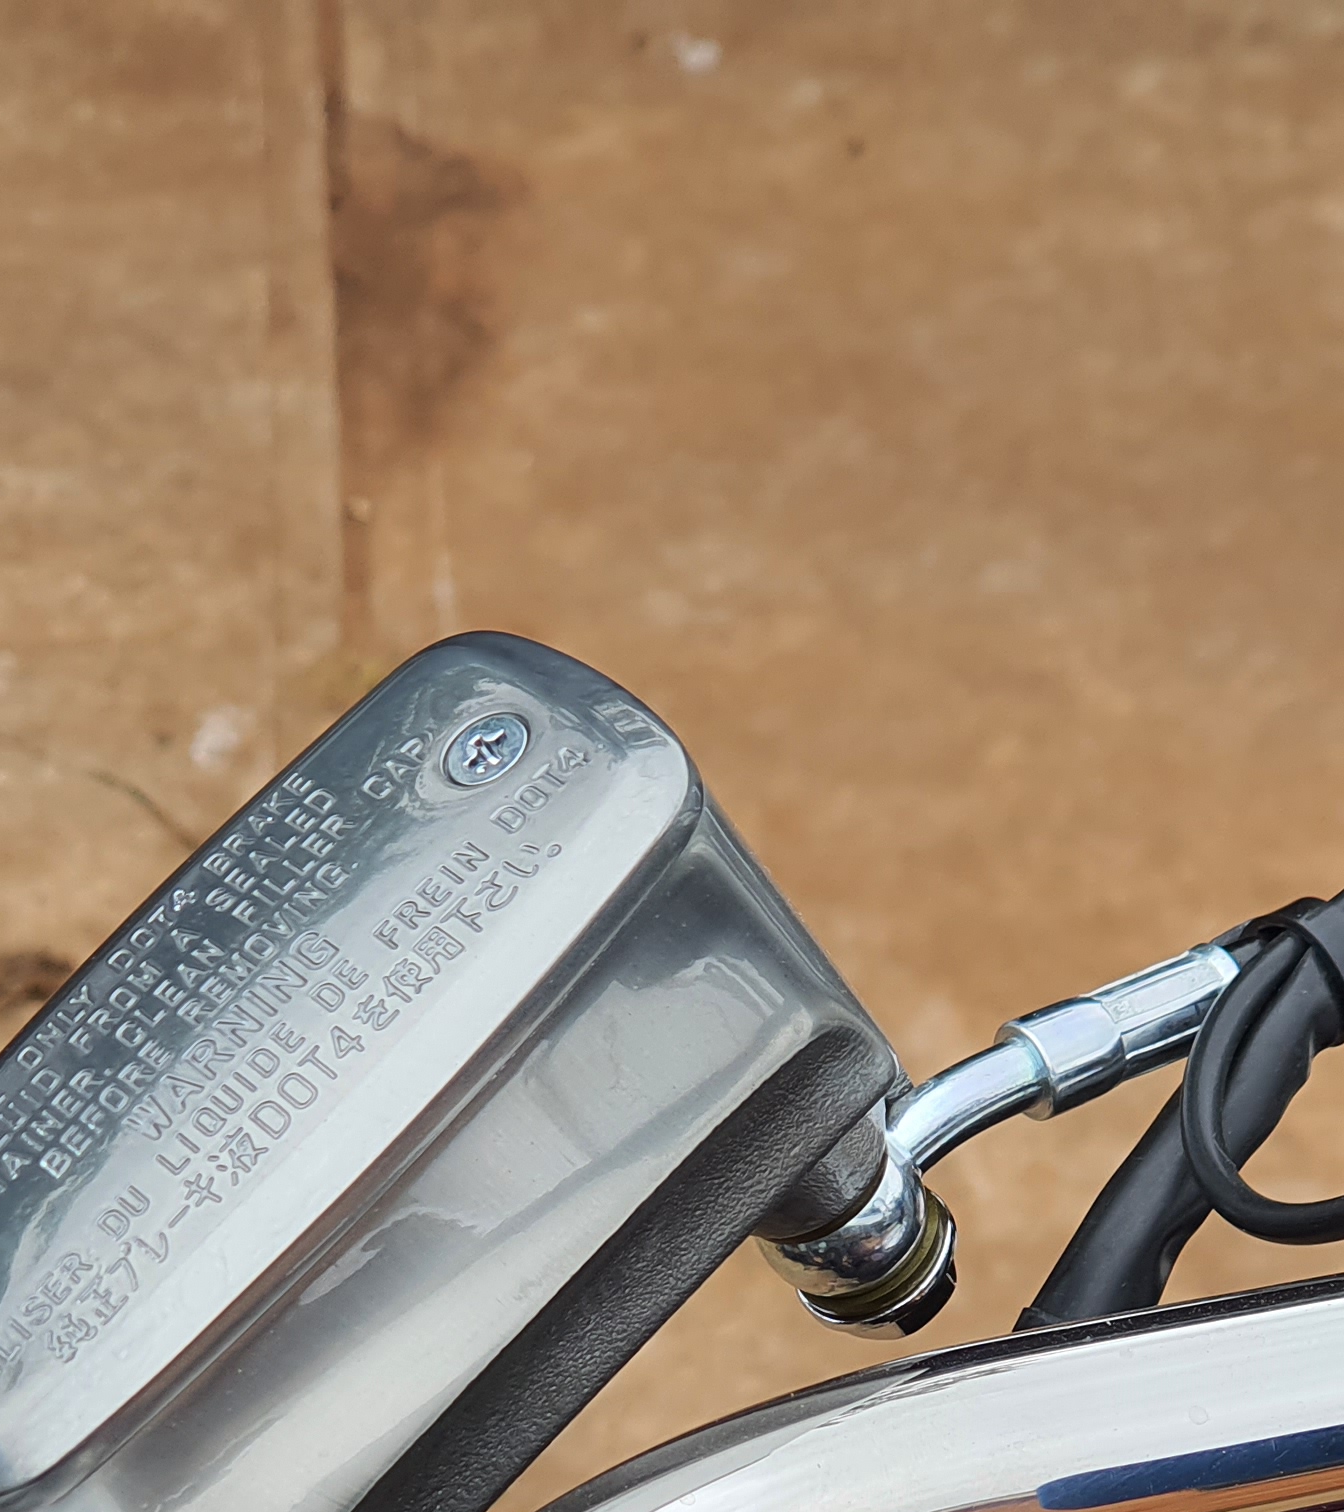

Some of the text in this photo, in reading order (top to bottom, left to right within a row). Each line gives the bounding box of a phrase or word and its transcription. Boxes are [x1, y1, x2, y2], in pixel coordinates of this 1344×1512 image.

[16, 983, 94, 1070] ONLY
[106, 889, 195, 974] DOT4
[201, 770, 315, 878] BRAKE
[37, 858, 359, 1180] BEFORE REMOVING.
[68, 959, 164, 1056] FROM
[170, 927, 202, 953] A
[205, 785, 338, 915] SEALED
[94, 1183, 152, 1241] DU
[154, 1020, 307, 1177] LIQUIDE
[307, 956, 370, 1015] DE
[370, 839, 490, 950] FREIN
[114, 937, 226, 1050] CLEAN
[230, 811, 358, 928] FILLER
[361, 735, 425, 801] CAP
[121, 925, 341, 1142] WARNING
